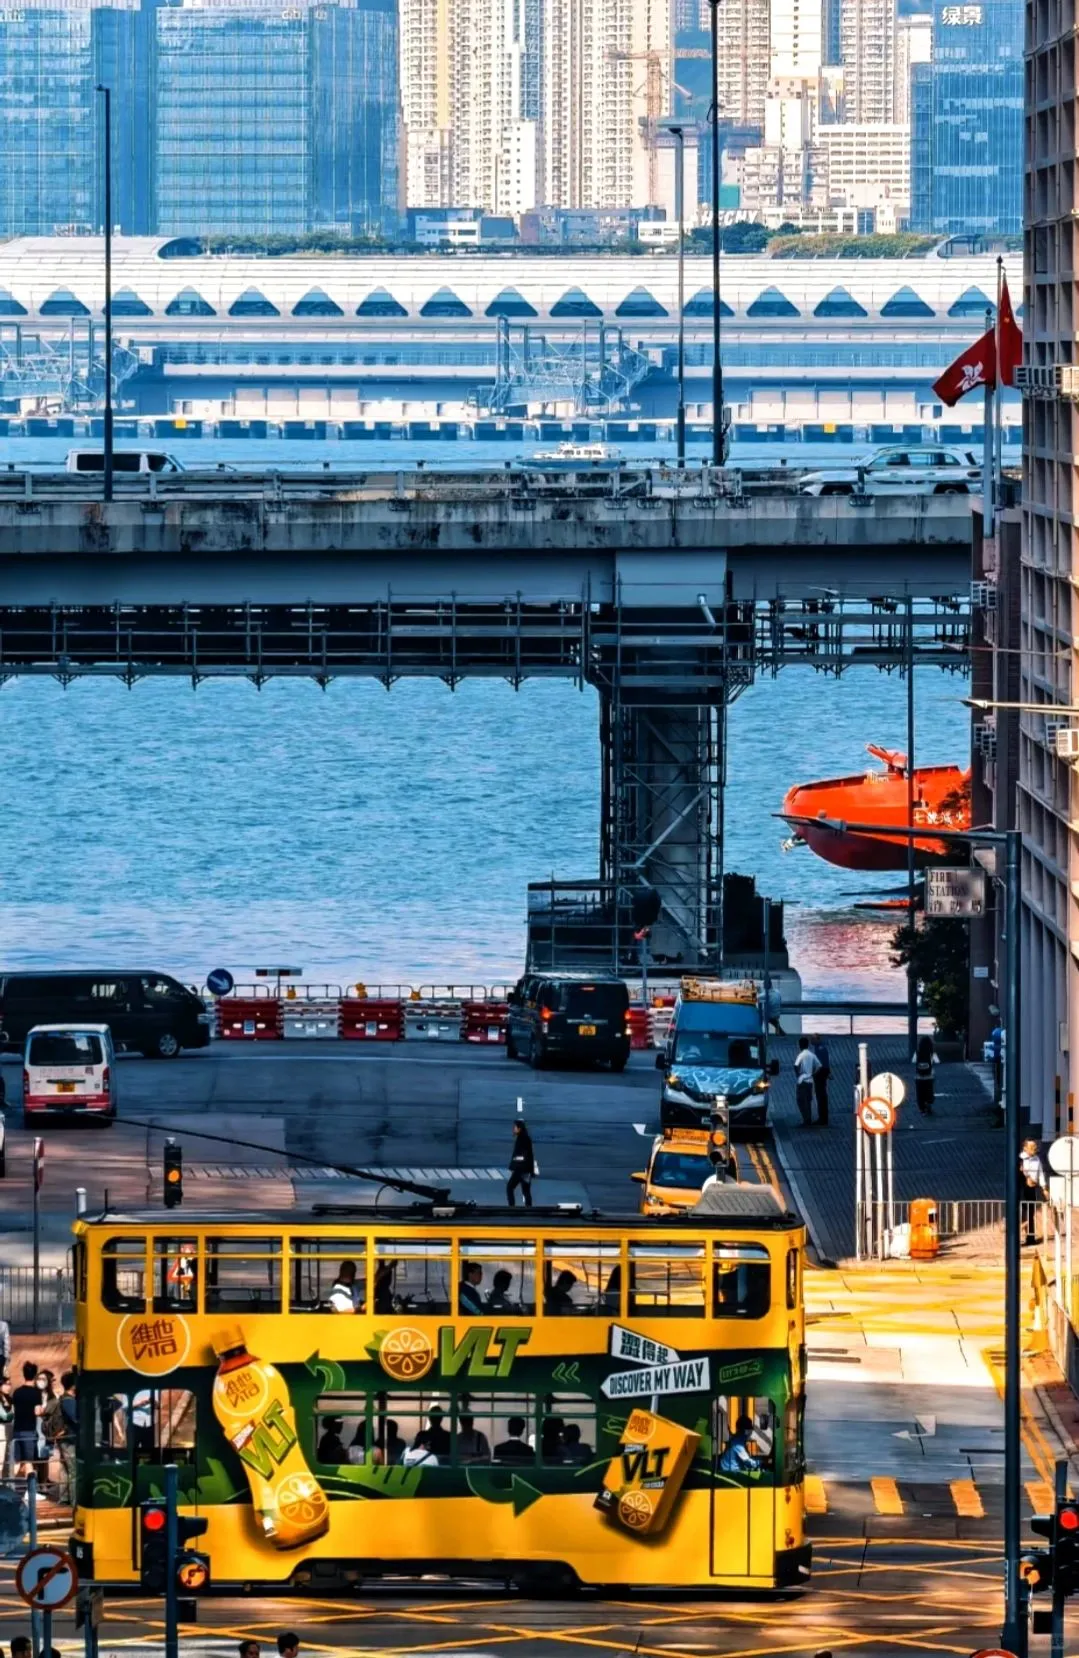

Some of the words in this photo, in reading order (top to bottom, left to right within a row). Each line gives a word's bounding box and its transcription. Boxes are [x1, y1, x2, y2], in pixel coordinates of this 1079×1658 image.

[131, 1319, 173, 1345] 維他
[437, 1325, 532, 1376] VLT
[609, 1371, 652, 1395] DISCOVER
[654, 1367, 671, 1391] MY
[673, 1361, 704, 1389] WAY
[239, 1399, 297, 1481] VLT
[620, 1446, 671, 1486] VLT
